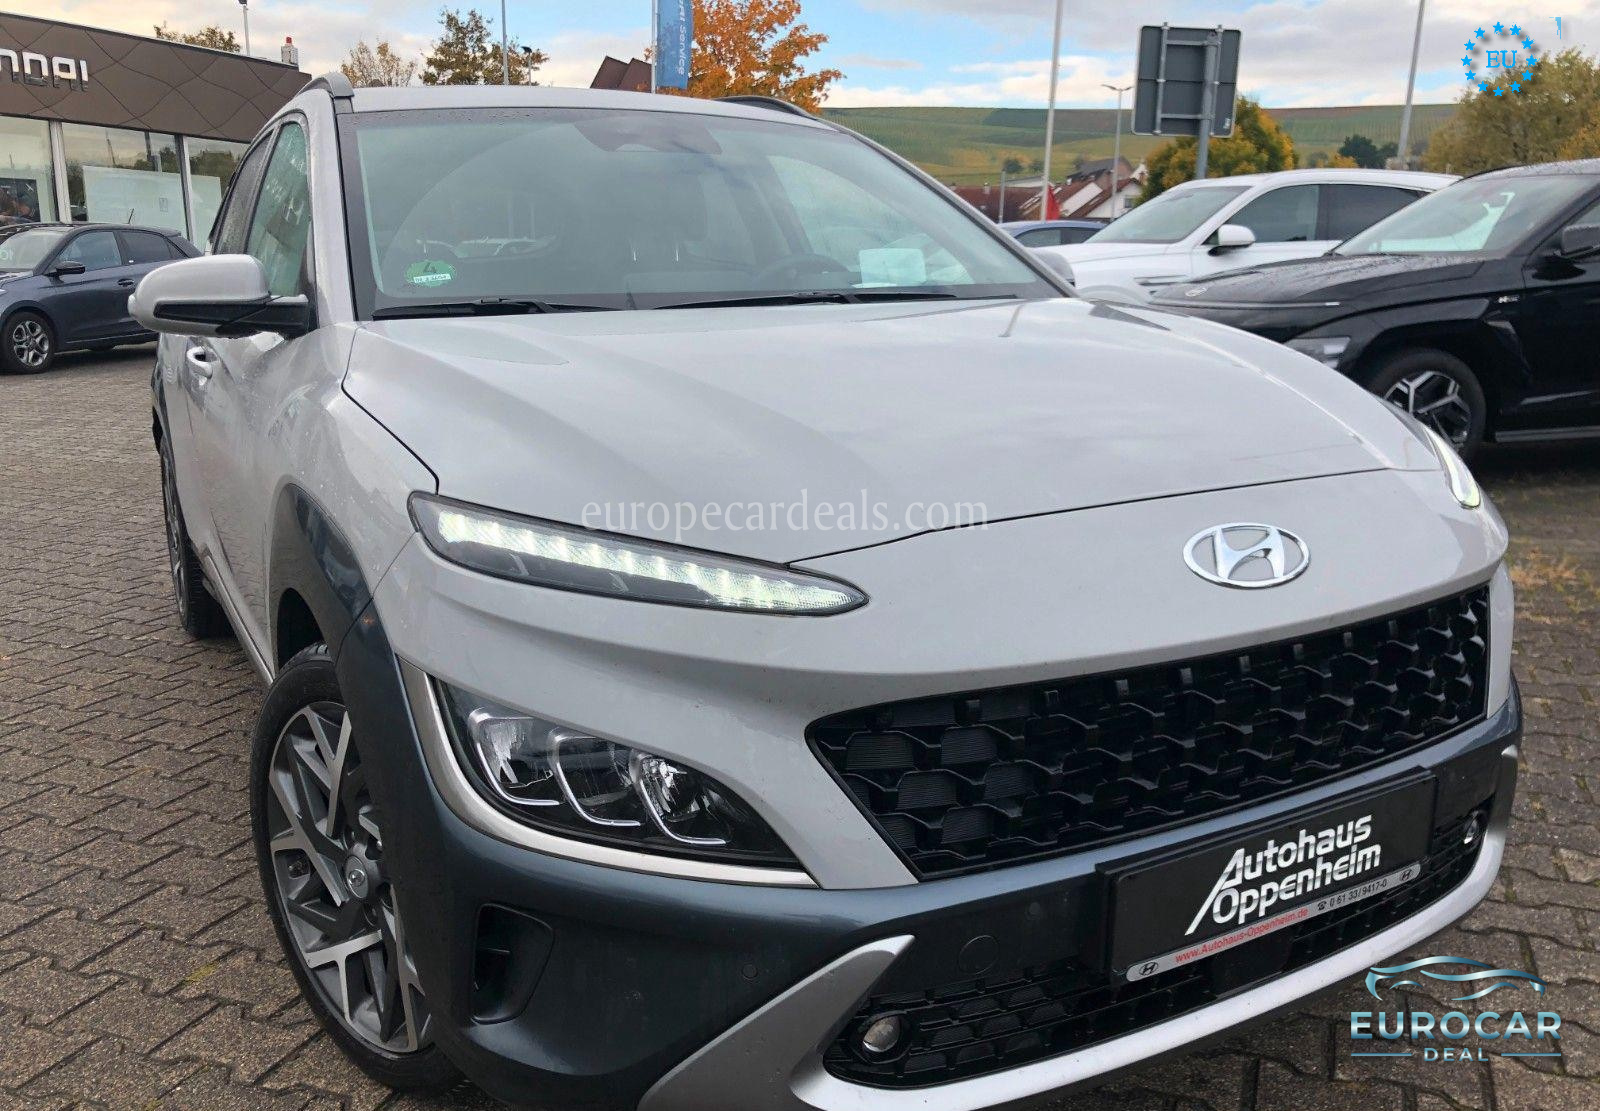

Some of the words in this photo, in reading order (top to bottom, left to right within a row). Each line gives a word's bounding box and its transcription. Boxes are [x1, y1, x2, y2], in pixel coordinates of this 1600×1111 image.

[1185, 815, 1373, 936] Autohaus
[1212, 844, 1382, 924] Oppenheim
[1175, 907, 1309, 964] www.Autohaus-Oppenheim.de
